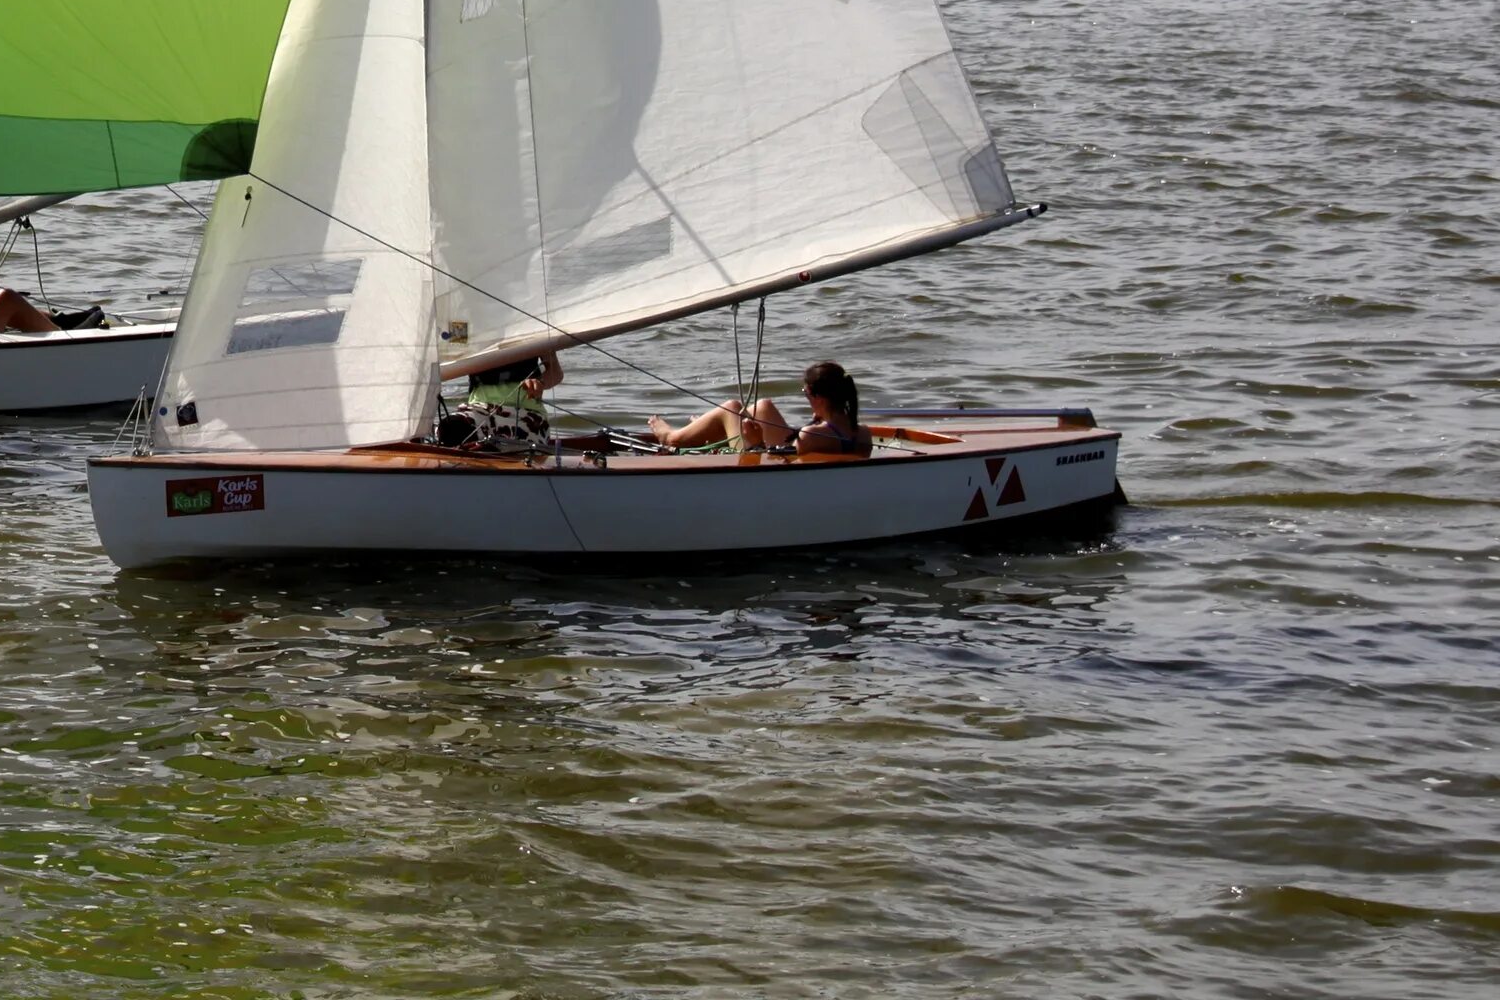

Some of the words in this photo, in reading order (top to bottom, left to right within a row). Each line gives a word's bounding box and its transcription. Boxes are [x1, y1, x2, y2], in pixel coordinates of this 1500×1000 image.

[217, 477, 258, 493] Karls
[173, 493, 213, 510] Karls
[223, 491, 252, 506] Cup
